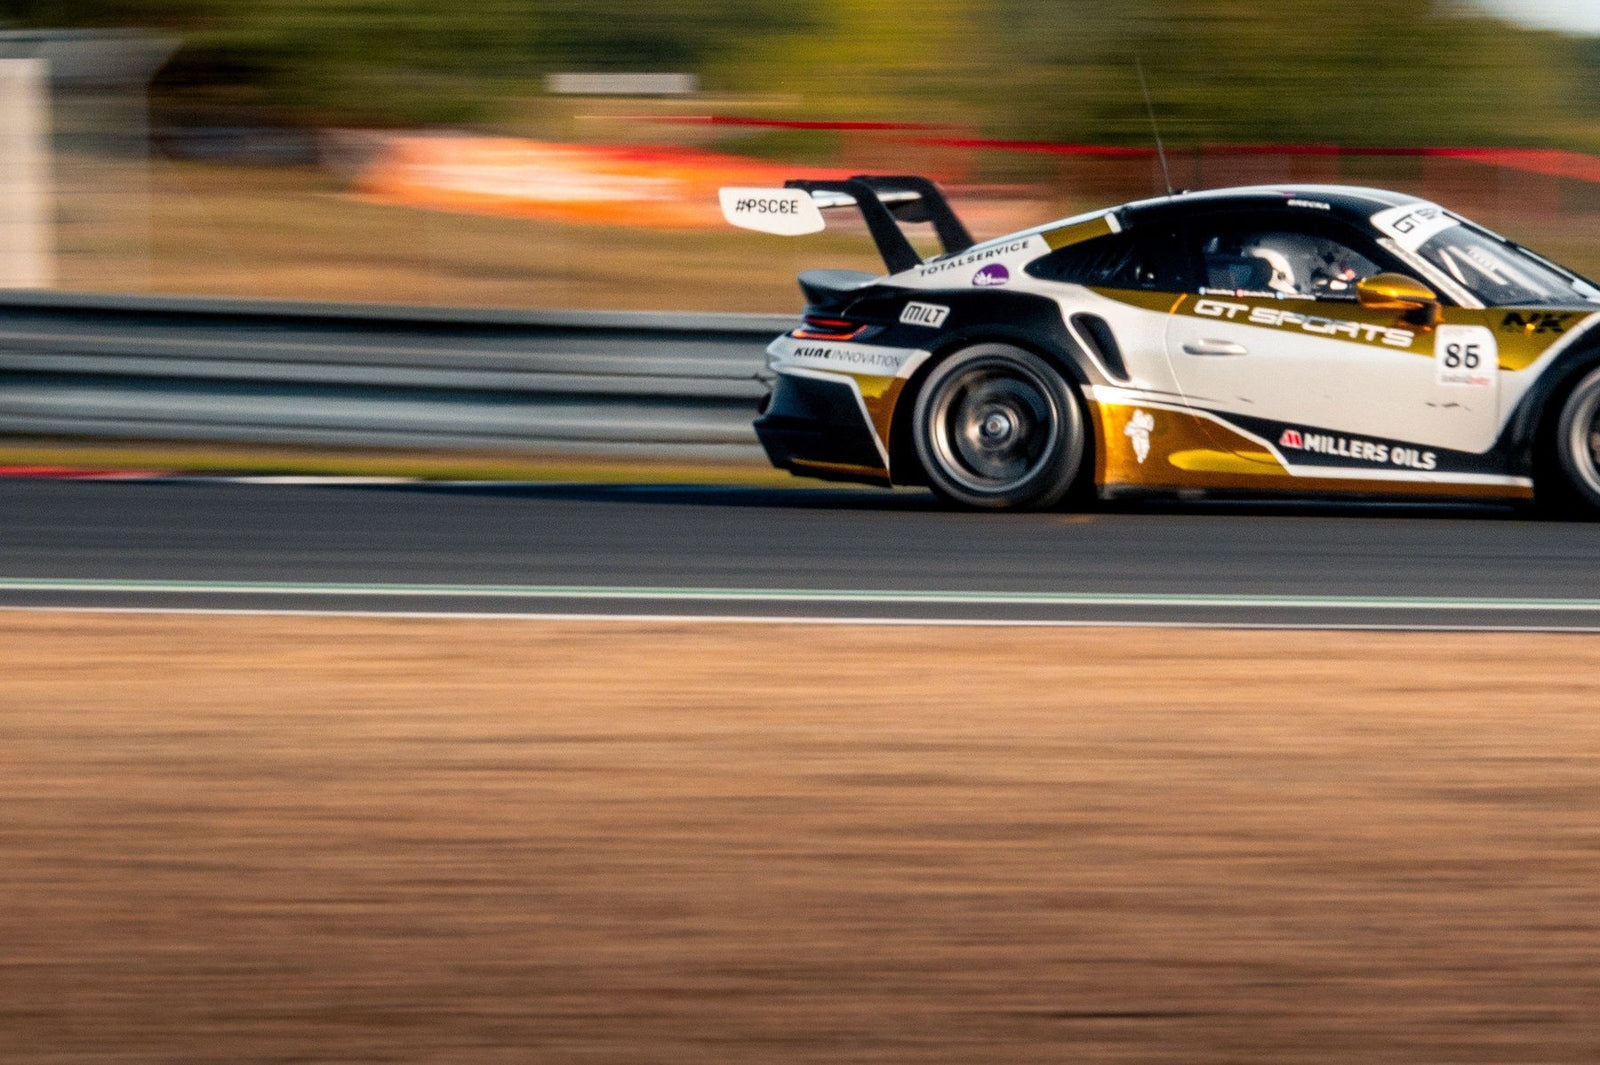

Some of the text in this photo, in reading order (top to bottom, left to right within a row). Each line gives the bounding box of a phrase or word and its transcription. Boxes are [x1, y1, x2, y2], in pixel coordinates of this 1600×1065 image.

[904, 305, 945, 324] MILT
[1194, 299, 1416, 348] GT SPORTS
[1444, 342, 1480, 369] 85
[1304, 433, 1437, 470] MILLERS OILS
